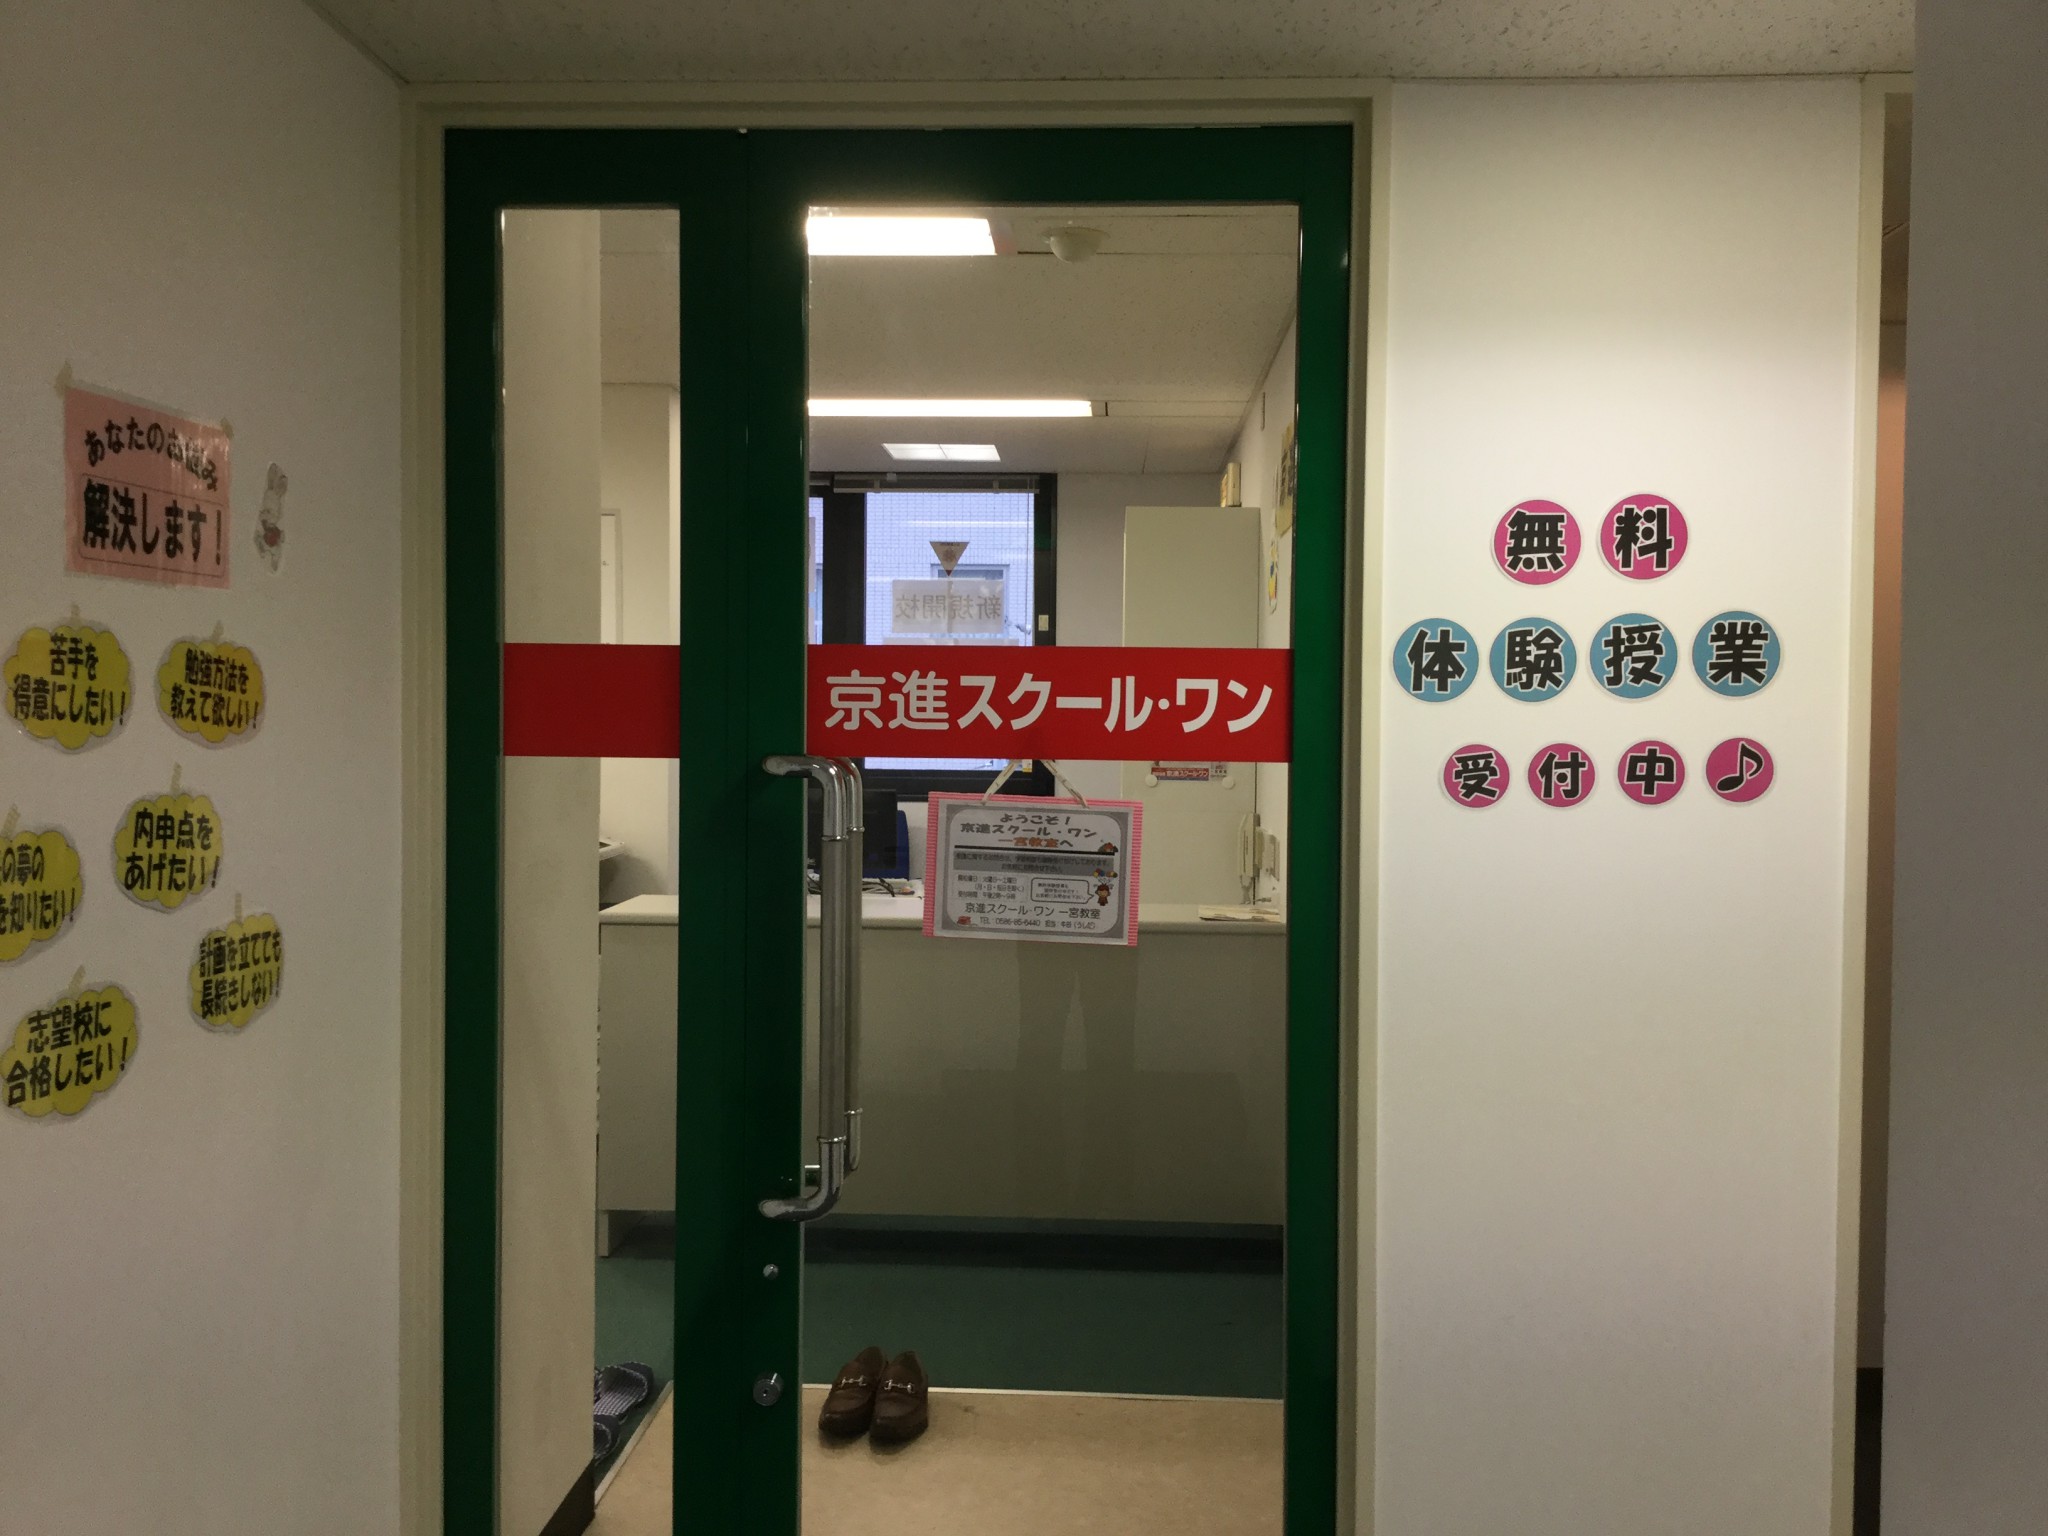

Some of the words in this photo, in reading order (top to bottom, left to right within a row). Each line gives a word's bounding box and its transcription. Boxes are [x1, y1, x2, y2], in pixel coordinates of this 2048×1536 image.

[83, 478, 221, 565] 解決します！
[1506, 505, 1674, 572] 無料
[50, 635, 98, 681] 苦手を
[185, 648, 249, 693] 勉強方法を
[1406, 620, 1769, 693] 体験授業
[13, 674, 127, 727] 得意にしたい！
[170, 683, 259, 729] 教えて欲しい！
[825, 669, 1273, 733] 京進スクール・ワン
[134, 808, 214, 849] 内申点を
[960, 822, 1097, 838] 京進スクール・ワン
[1000, 813, 1071, 826] ようこそ！
[0, 843, 45, 886] の夢の
[124, 852, 220, 892] あげたい！
[965, 902, 1056, 917] 京進スクール・ワン
[1059, 907, 1101, 920] 一宮教室
[199, 929, 282, 978] 計画を立てても
[201, 966, 280, 1019] 長続きしない！
[27, 1001, 113, 1053] 志望校に
[6, 1036, 128, 1108] 合格したい！
